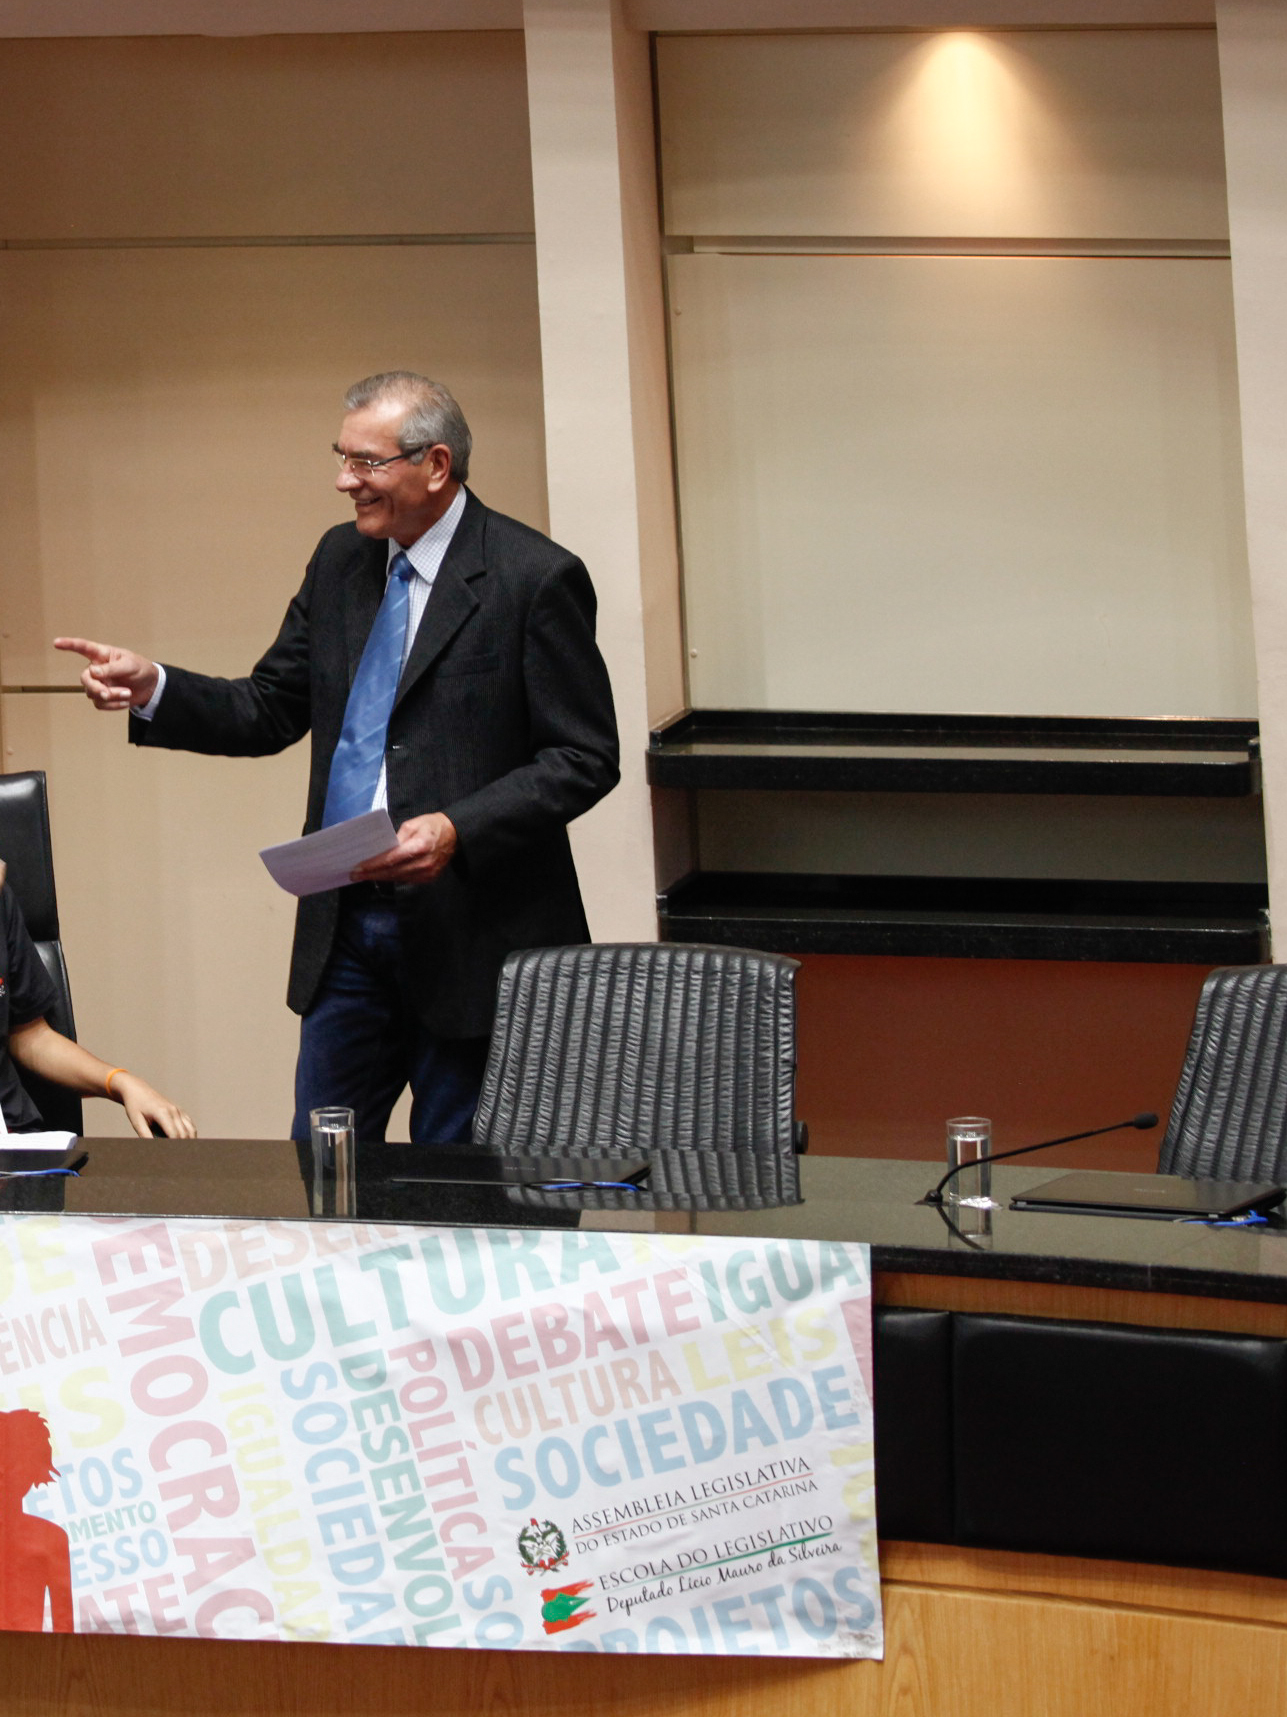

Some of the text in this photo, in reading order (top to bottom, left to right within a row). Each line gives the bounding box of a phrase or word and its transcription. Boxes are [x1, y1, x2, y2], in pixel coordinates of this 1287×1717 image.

[199, 1226, 621, 1375] CULTURA
[446, 1267, 702, 1392] DEBATE
[473, 1349, 682, 1446] CULTURA
[681, 1306, 838, 1393] LEIS
[387, 1338, 496, 1582] POLÍTICA
[493, 1364, 860, 1512] SOCIEDADE
[339, 1348, 467, 1648] DESENVOL
[571, 1456, 811, 1534] ASSEMBLEIA LEGISLATIVA
[576, 1479, 818, 1555] DO ESTADO DE SANTA CATARINA
[599, 1514, 834, 1591] ESCOLA DO LEGISLATIVO
[607, 1581, 674, 1616] Deputado
[716, 1563, 763, 1585] Mauro
[767, 1551, 787, 1567] da
[789, 1539, 842, 1564] Silveira
